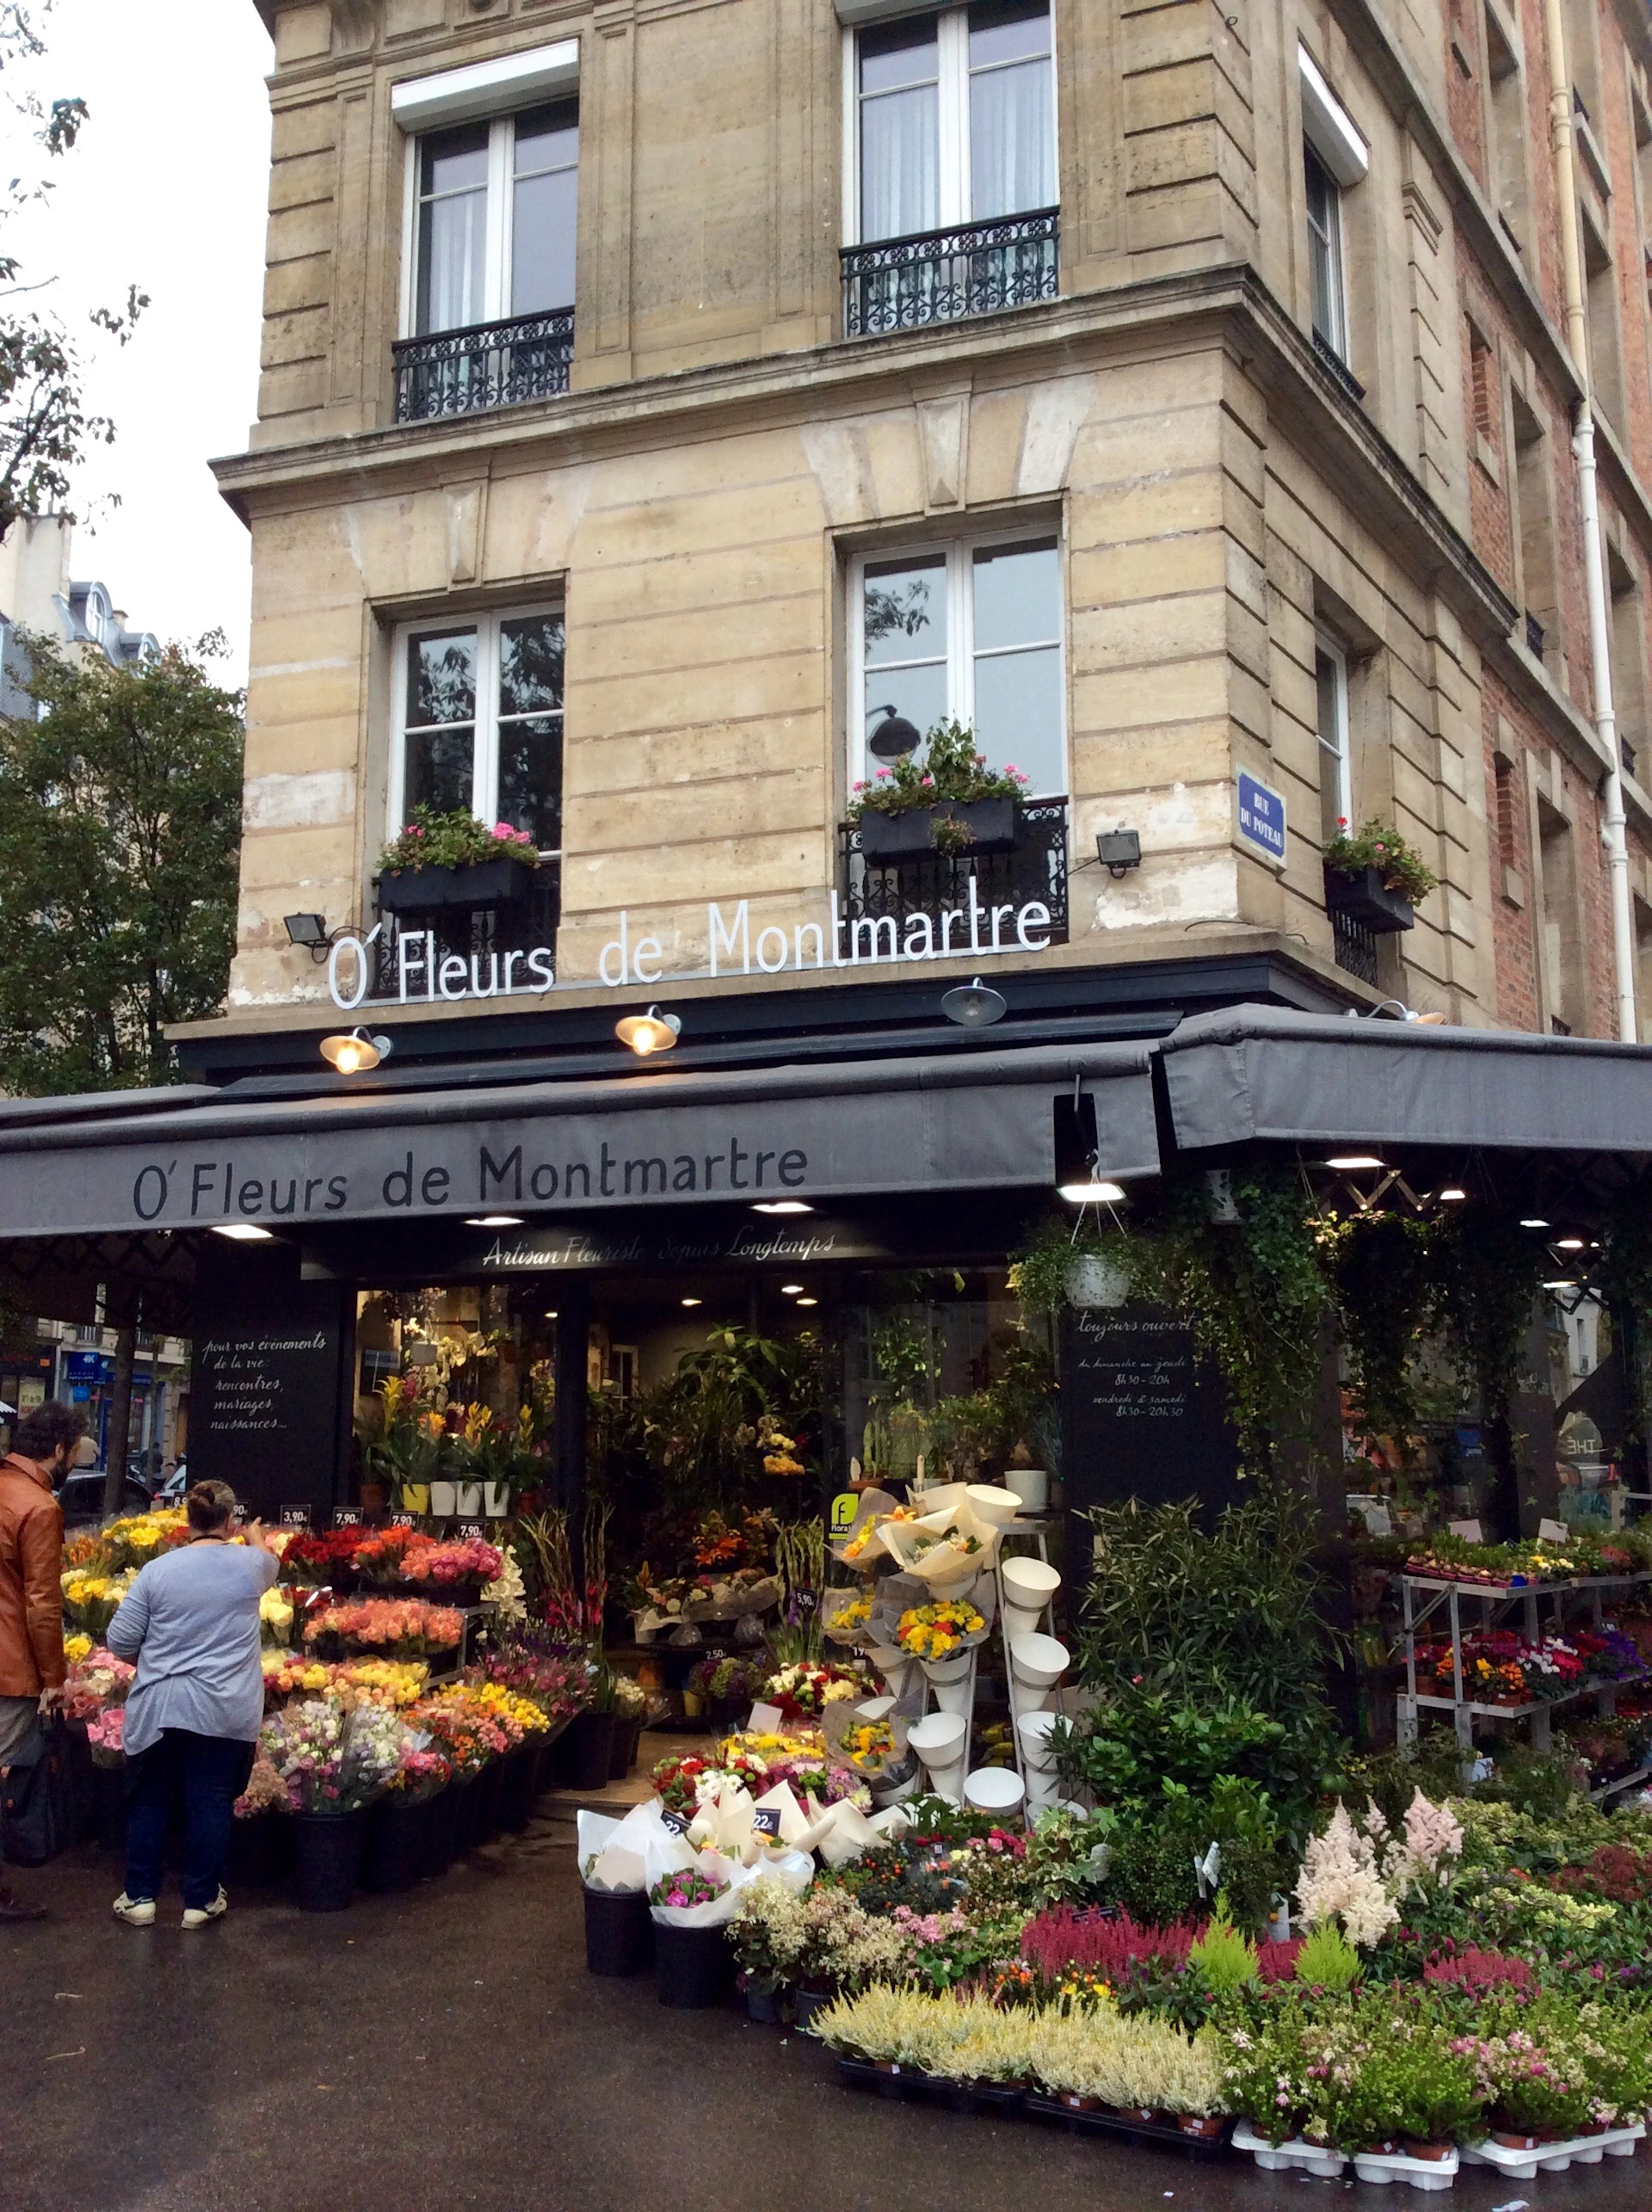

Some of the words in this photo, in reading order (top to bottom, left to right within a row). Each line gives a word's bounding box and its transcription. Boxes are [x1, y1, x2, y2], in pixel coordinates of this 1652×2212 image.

[1254, 792, 1269, 816] RUE
[1241, 807, 1251, 827] DU
[1254, 816, 1283, 847] POTEAU
[600, 910, 663, 987] de
[709, 876, 1051, 977] Montmartre
[383, 1151, 449, 1207] de
[480, 1137, 808, 1201] Montmartre
[482, 1237, 561, 1266] Artisan
[563, 1235, 645, 1263] Fleuriste
[725, 1224, 835, 1260] Longtemps
[1076, 1310, 1137, 1342] toujours
[1142, 1311, 1197, 1332] ouvert
[202, 1340, 231, 1365] pour
[235, 1340, 255, 1351] vos
[213, 1355, 226, 1370] de
[231, 1354, 242, 1369] la
[1093, 1357, 1136, 1368] dimanche
[1154, 1356, 1186, 1372] jeudi
[215, 1374, 284, 1392] rencontres,
[1093, 1393, 1131, 1403] vendredi
[1150, 1393, 1186, 1403] samedi
[284, 1511, 308, 1523] 3,90€
[336, 1513, 359, 1525] 7,90€
[459, 1525, 484, 1537] 7,90€
[754, 1815, 774, 1829] 22€
